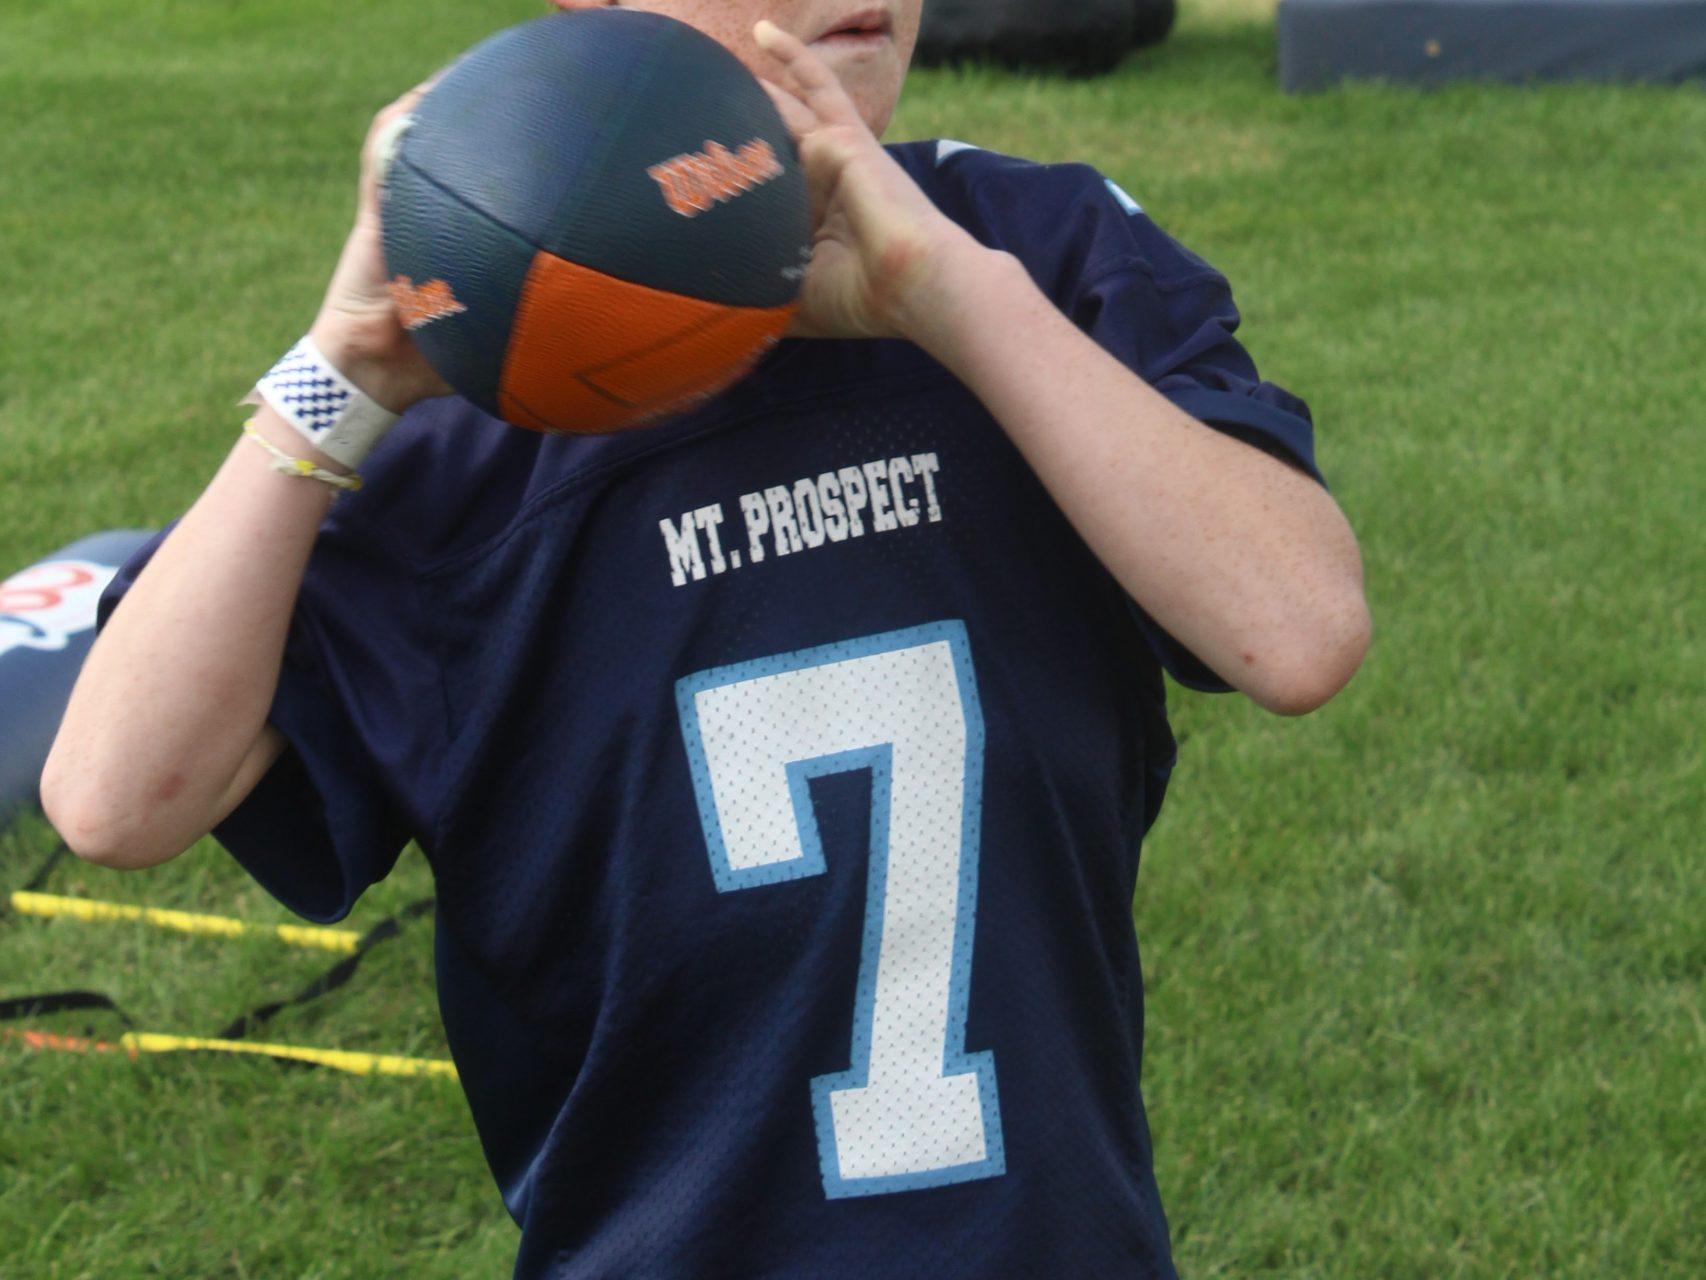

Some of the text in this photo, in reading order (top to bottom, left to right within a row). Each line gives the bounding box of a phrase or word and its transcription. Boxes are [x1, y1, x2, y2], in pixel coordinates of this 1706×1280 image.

[658, 452, 943, 587] MT. PROSPECT
[675, 619, 1006, 1200] 7
